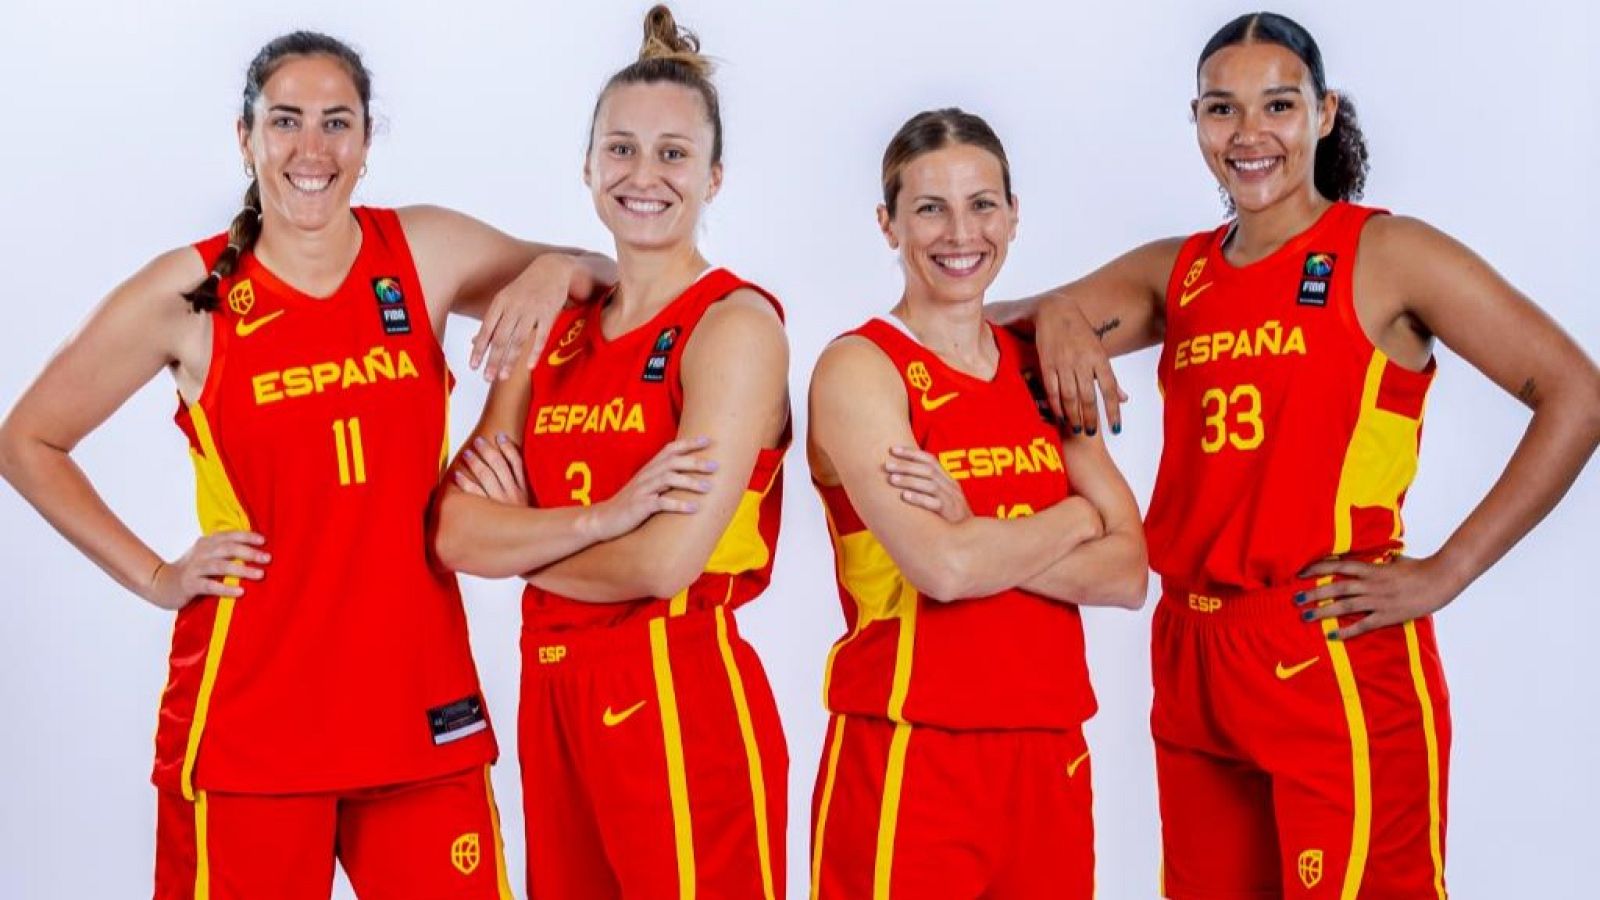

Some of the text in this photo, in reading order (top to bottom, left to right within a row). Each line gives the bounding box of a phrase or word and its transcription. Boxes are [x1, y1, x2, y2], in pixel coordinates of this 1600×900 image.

[1174, 320, 1307, 371] ESPAÑA
[252, 346, 419, 406] ESPAÑA
[534, 397, 645, 434] ESPAÑA
[1201, 385, 1265, 454] 33
[332, 416, 367, 486] 11
[565, 461, 592, 507] 3
[1189, 594, 1223, 614] ESP
[538, 645, 567, 664] ESP
